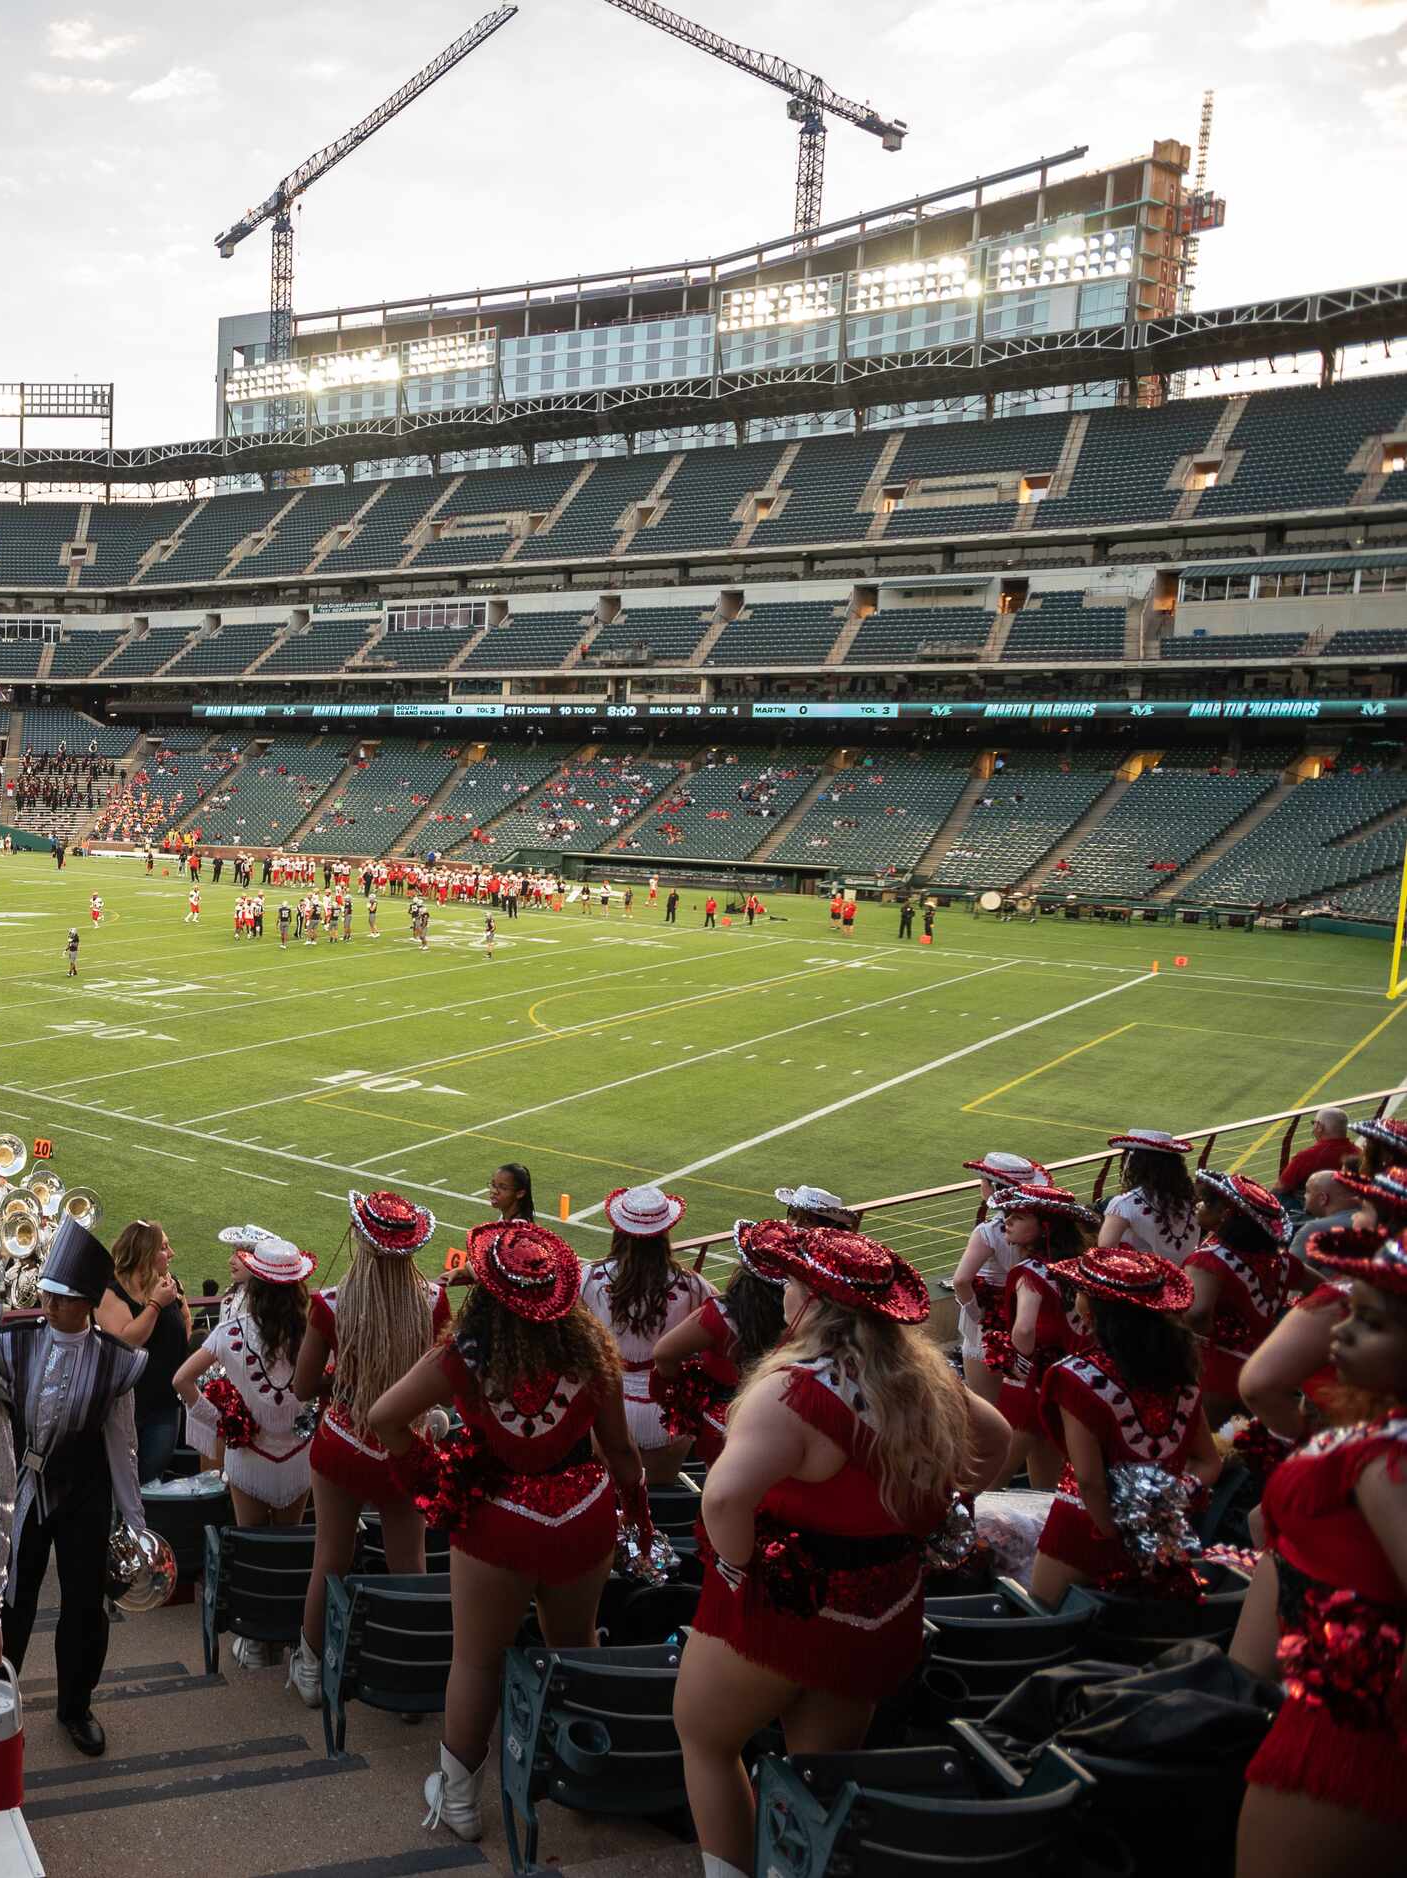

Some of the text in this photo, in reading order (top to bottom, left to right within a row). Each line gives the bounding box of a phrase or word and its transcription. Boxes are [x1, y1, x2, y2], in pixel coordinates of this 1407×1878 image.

[206, 706, 266, 716] MARTIN WARRIORS
[312, 706, 380, 716] MARTIN WARRIORS
[456, 706, 463, 714] 0
[506, 706, 525, 715] 4TH
[560, 706, 572, 715] 10
[608, 706, 636, 716] 8:00
[686, 706, 700, 715] 30
[709, 706, 738, 715] QTR 1
[799, 706, 807, 714] 0
[882, 706, 890, 714] 3
[984, 703, 1097, 717] MARTIN WARRIORS
[1190, 702, 1322, 717] MARTIN WARRIORS
[312, 1070, 423, 1092] 10
[34, 1141, 50, 1156] 10
